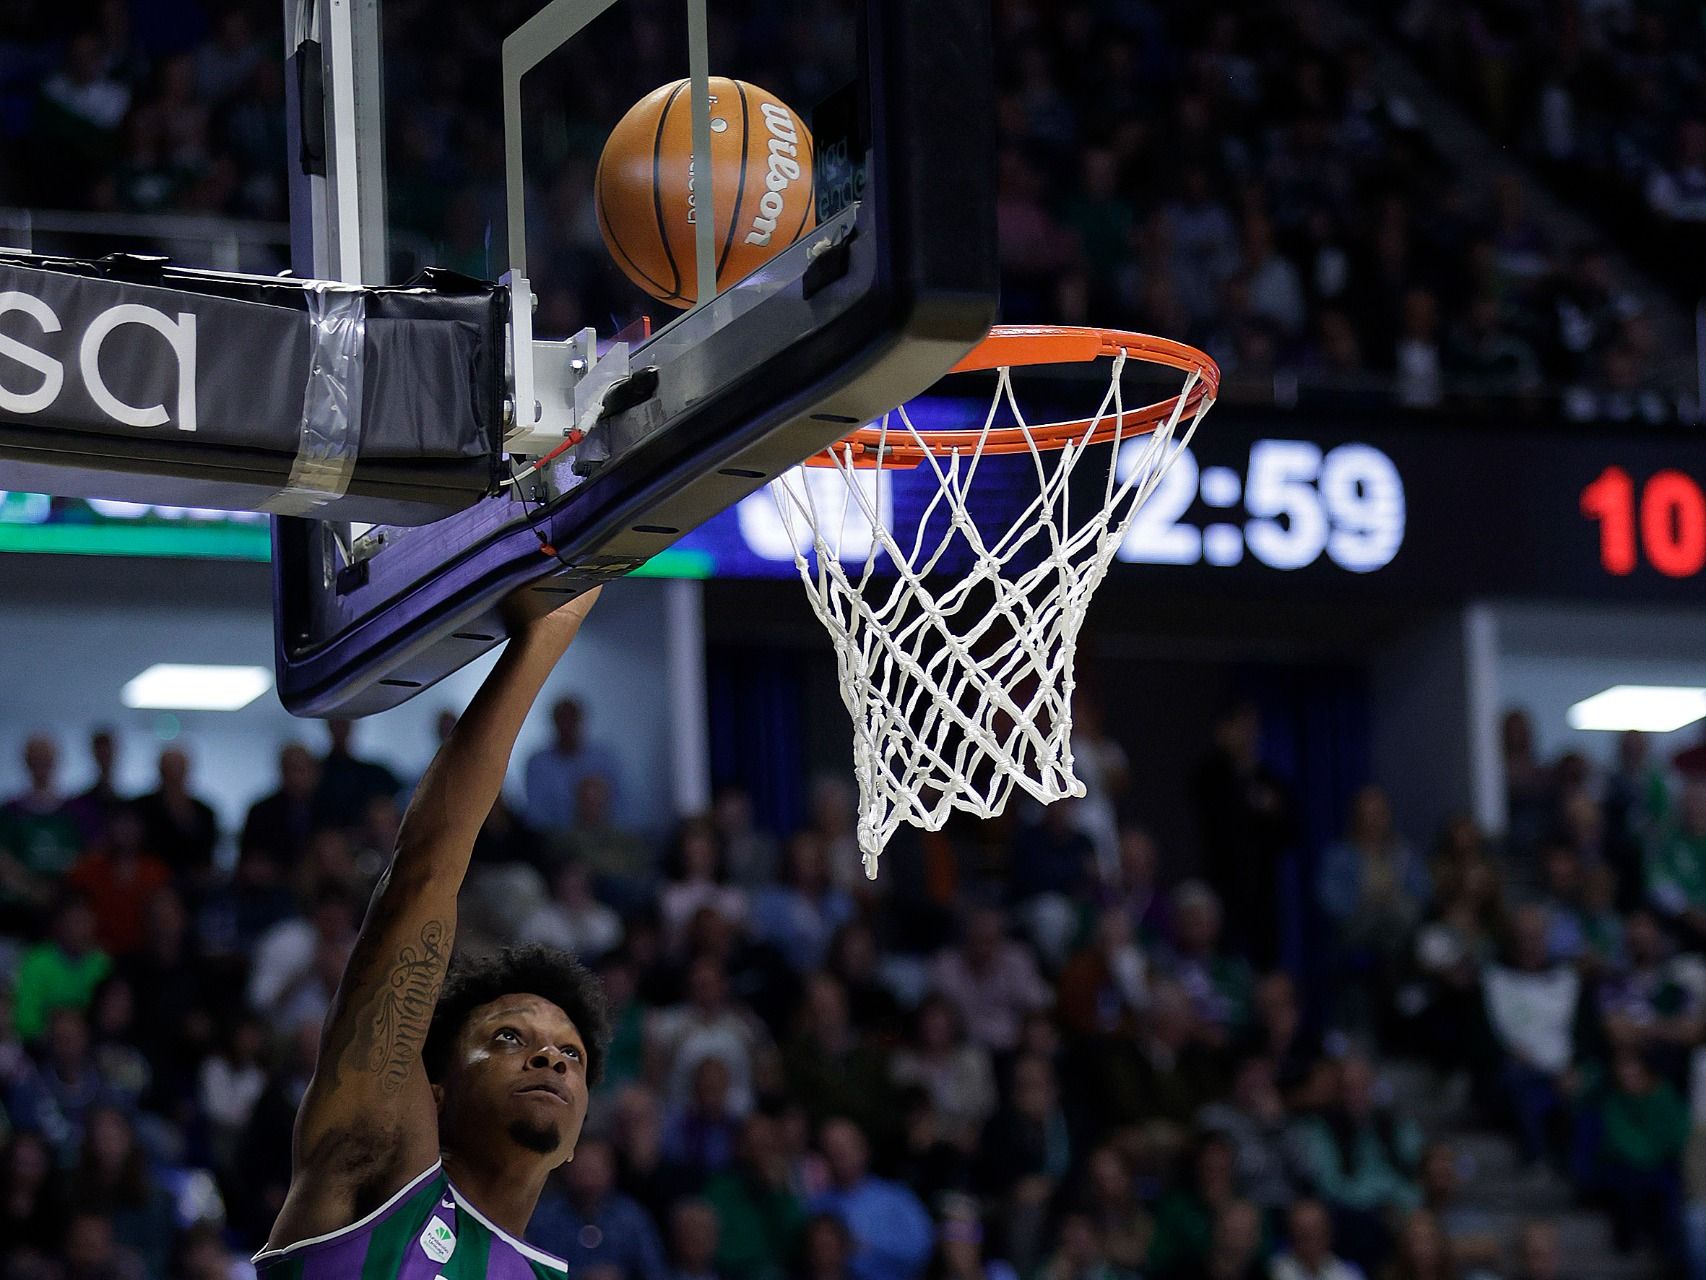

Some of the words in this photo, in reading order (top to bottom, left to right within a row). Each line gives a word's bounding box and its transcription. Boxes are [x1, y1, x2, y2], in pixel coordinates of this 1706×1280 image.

[744, 103, 801, 247] Wilson
[0, 291, 197, 432] sa
[1116, 437, 1406, 574] 2:59
[1580, 465, 1706, 578] 10
